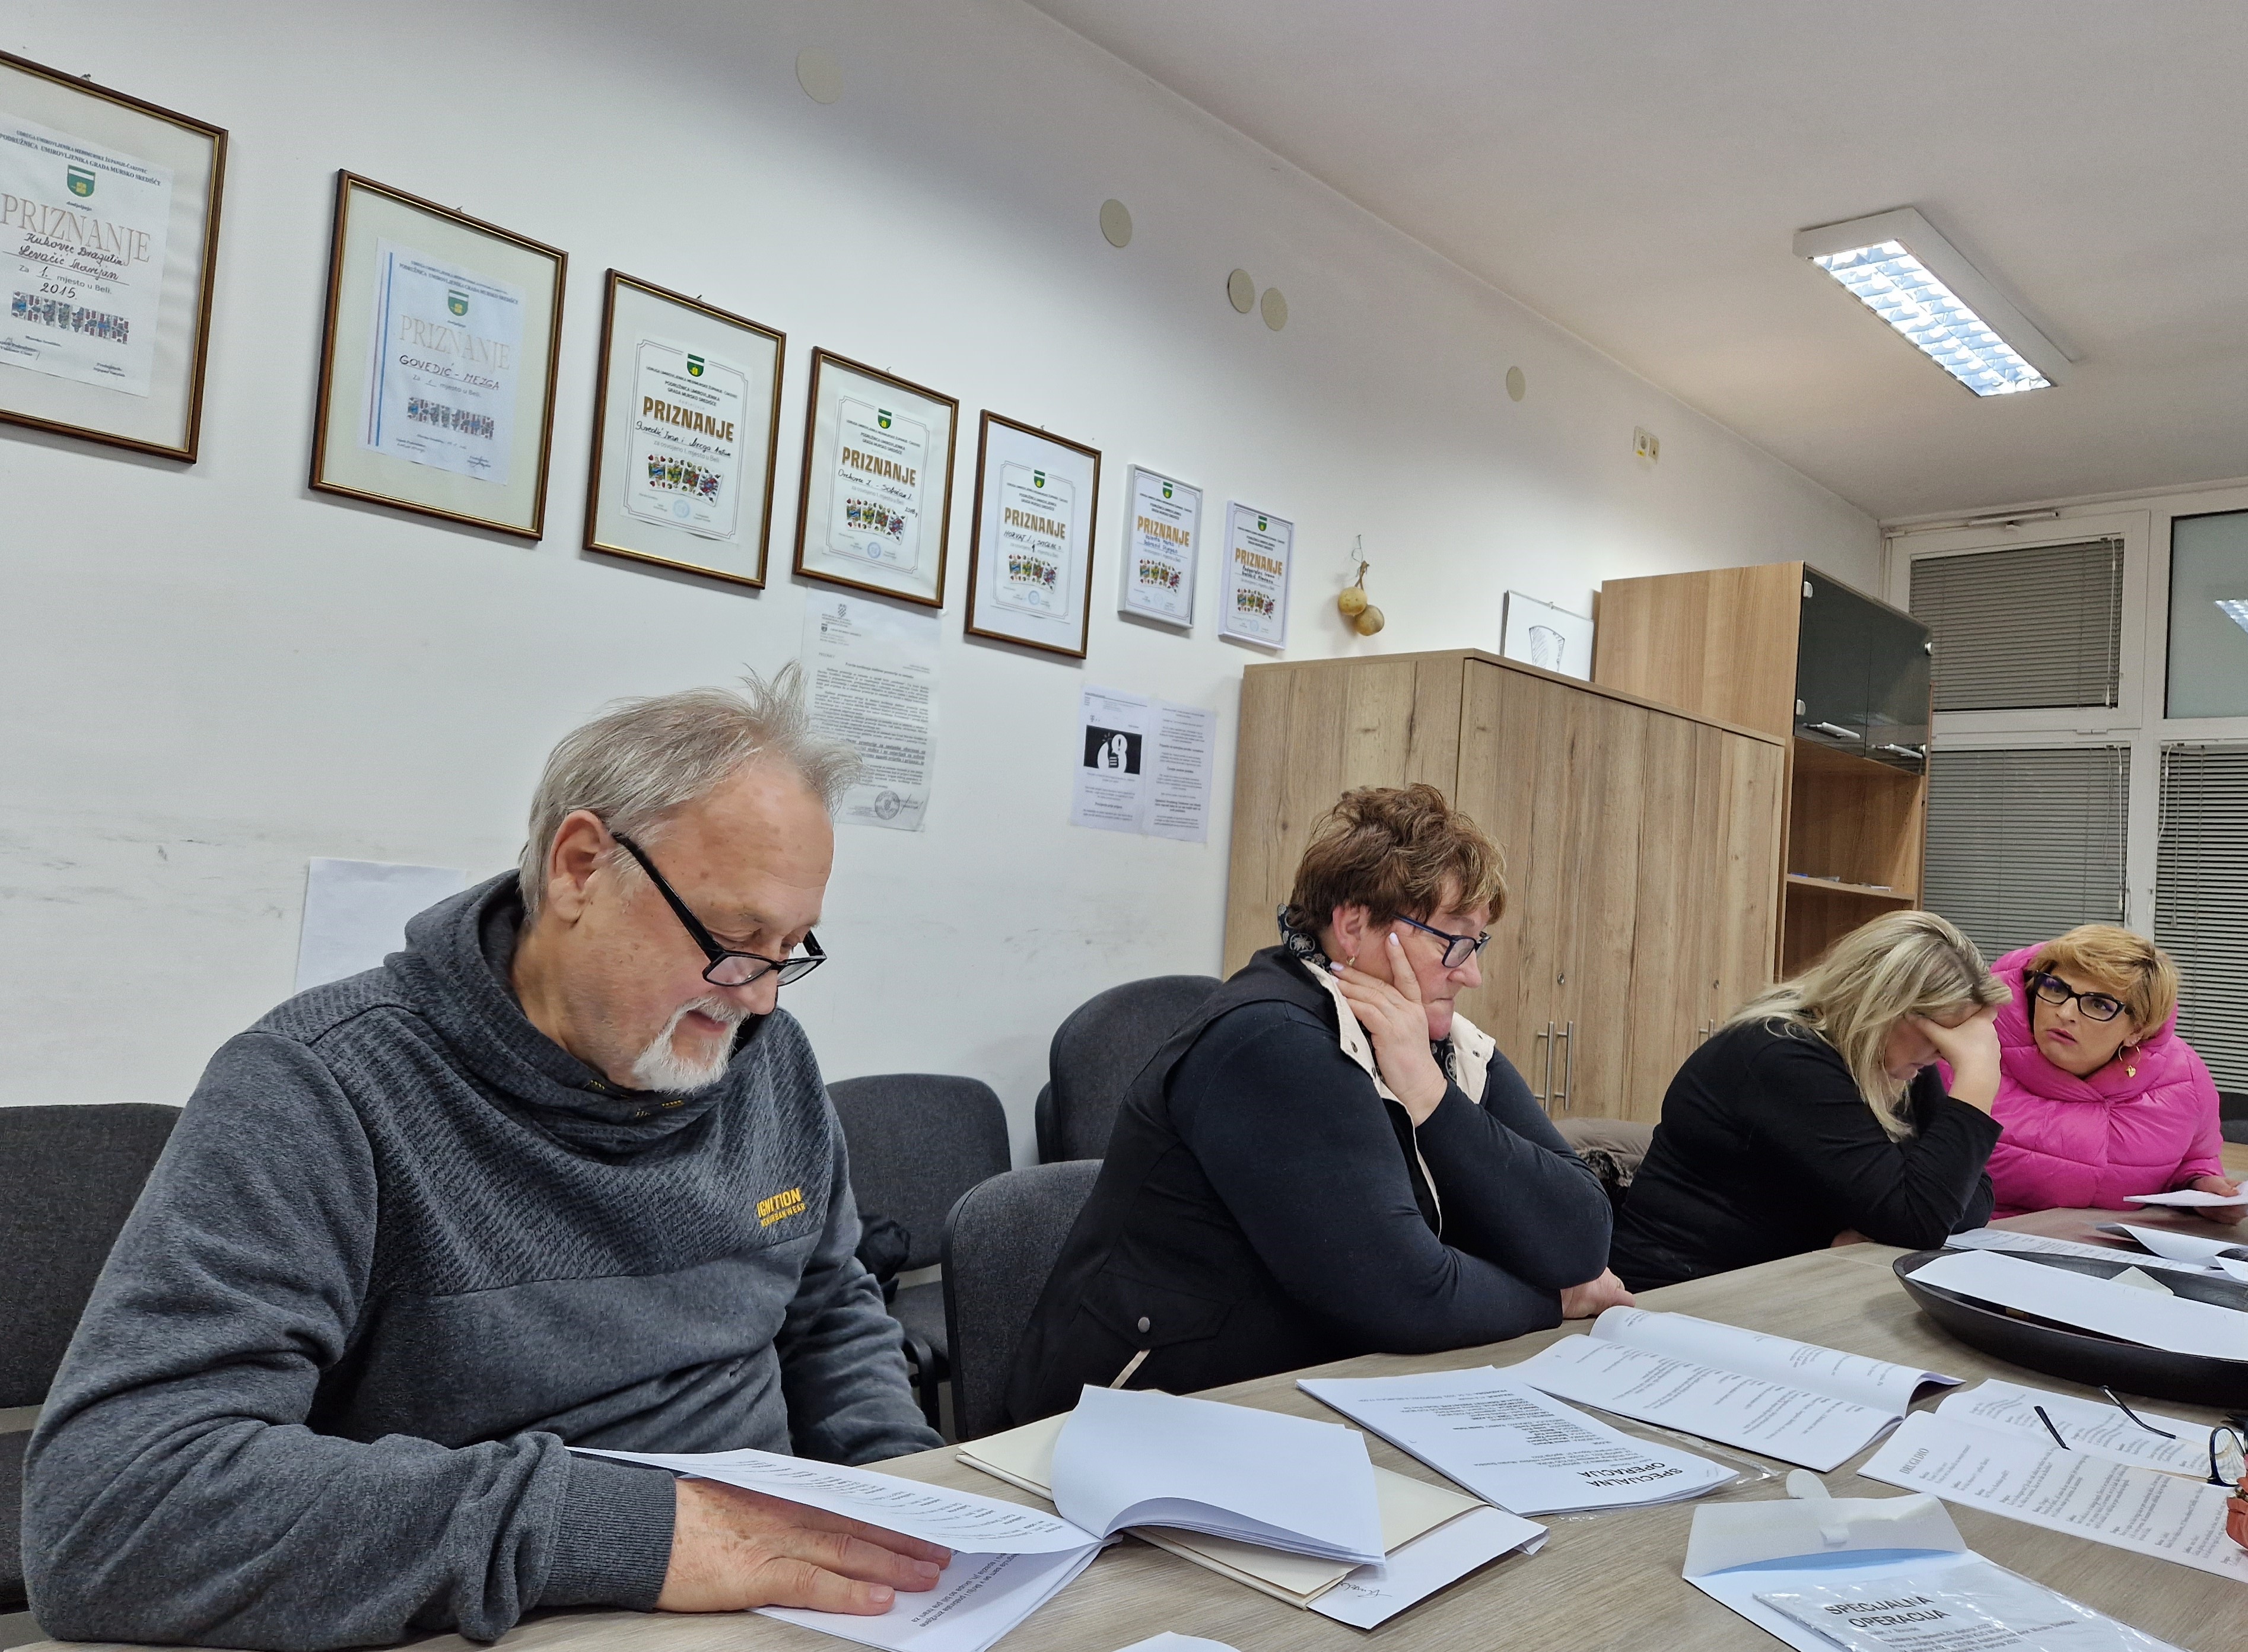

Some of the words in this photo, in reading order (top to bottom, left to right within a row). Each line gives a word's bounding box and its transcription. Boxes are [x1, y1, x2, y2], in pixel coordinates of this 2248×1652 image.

[41, 146, 89, 165] UMIROVLJENIKA
[90, 159, 109, 171] GRADA
[110, 166, 135, 179] MURSKO
[135, 173, 161, 187] SREDIŠĆE
[0, 193, 151, 266] PRIZNANJE
[57, 275, 85, 288] mjesto
[399, 314, 510, 374] PRIZNANJE
[642, 396, 735, 443] PRIZNANJE
[841, 446, 917, 488] PRIZNANJE
[1004, 507, 1066, 540] PRIZNANJE
[1137, 515, 1190, 547] PRIZNANJE
[1235, 548, 1283, 577] PRIZNANJE
[756, 1187, 801, 1218] IGNITION
[1576, 1462, 1667, 1478] OPERACIJA
[1899, 1457, 1921, 1475] DRUGI
[1913, 1448, 1930, 1460] DIO
[1585, 1468, 1684, 1487] SPECIJALNA
[1824, 1596, 1936, 1615] SPECIJALNA
[1848, 1609, 1951, 1627] OPERACIJA
